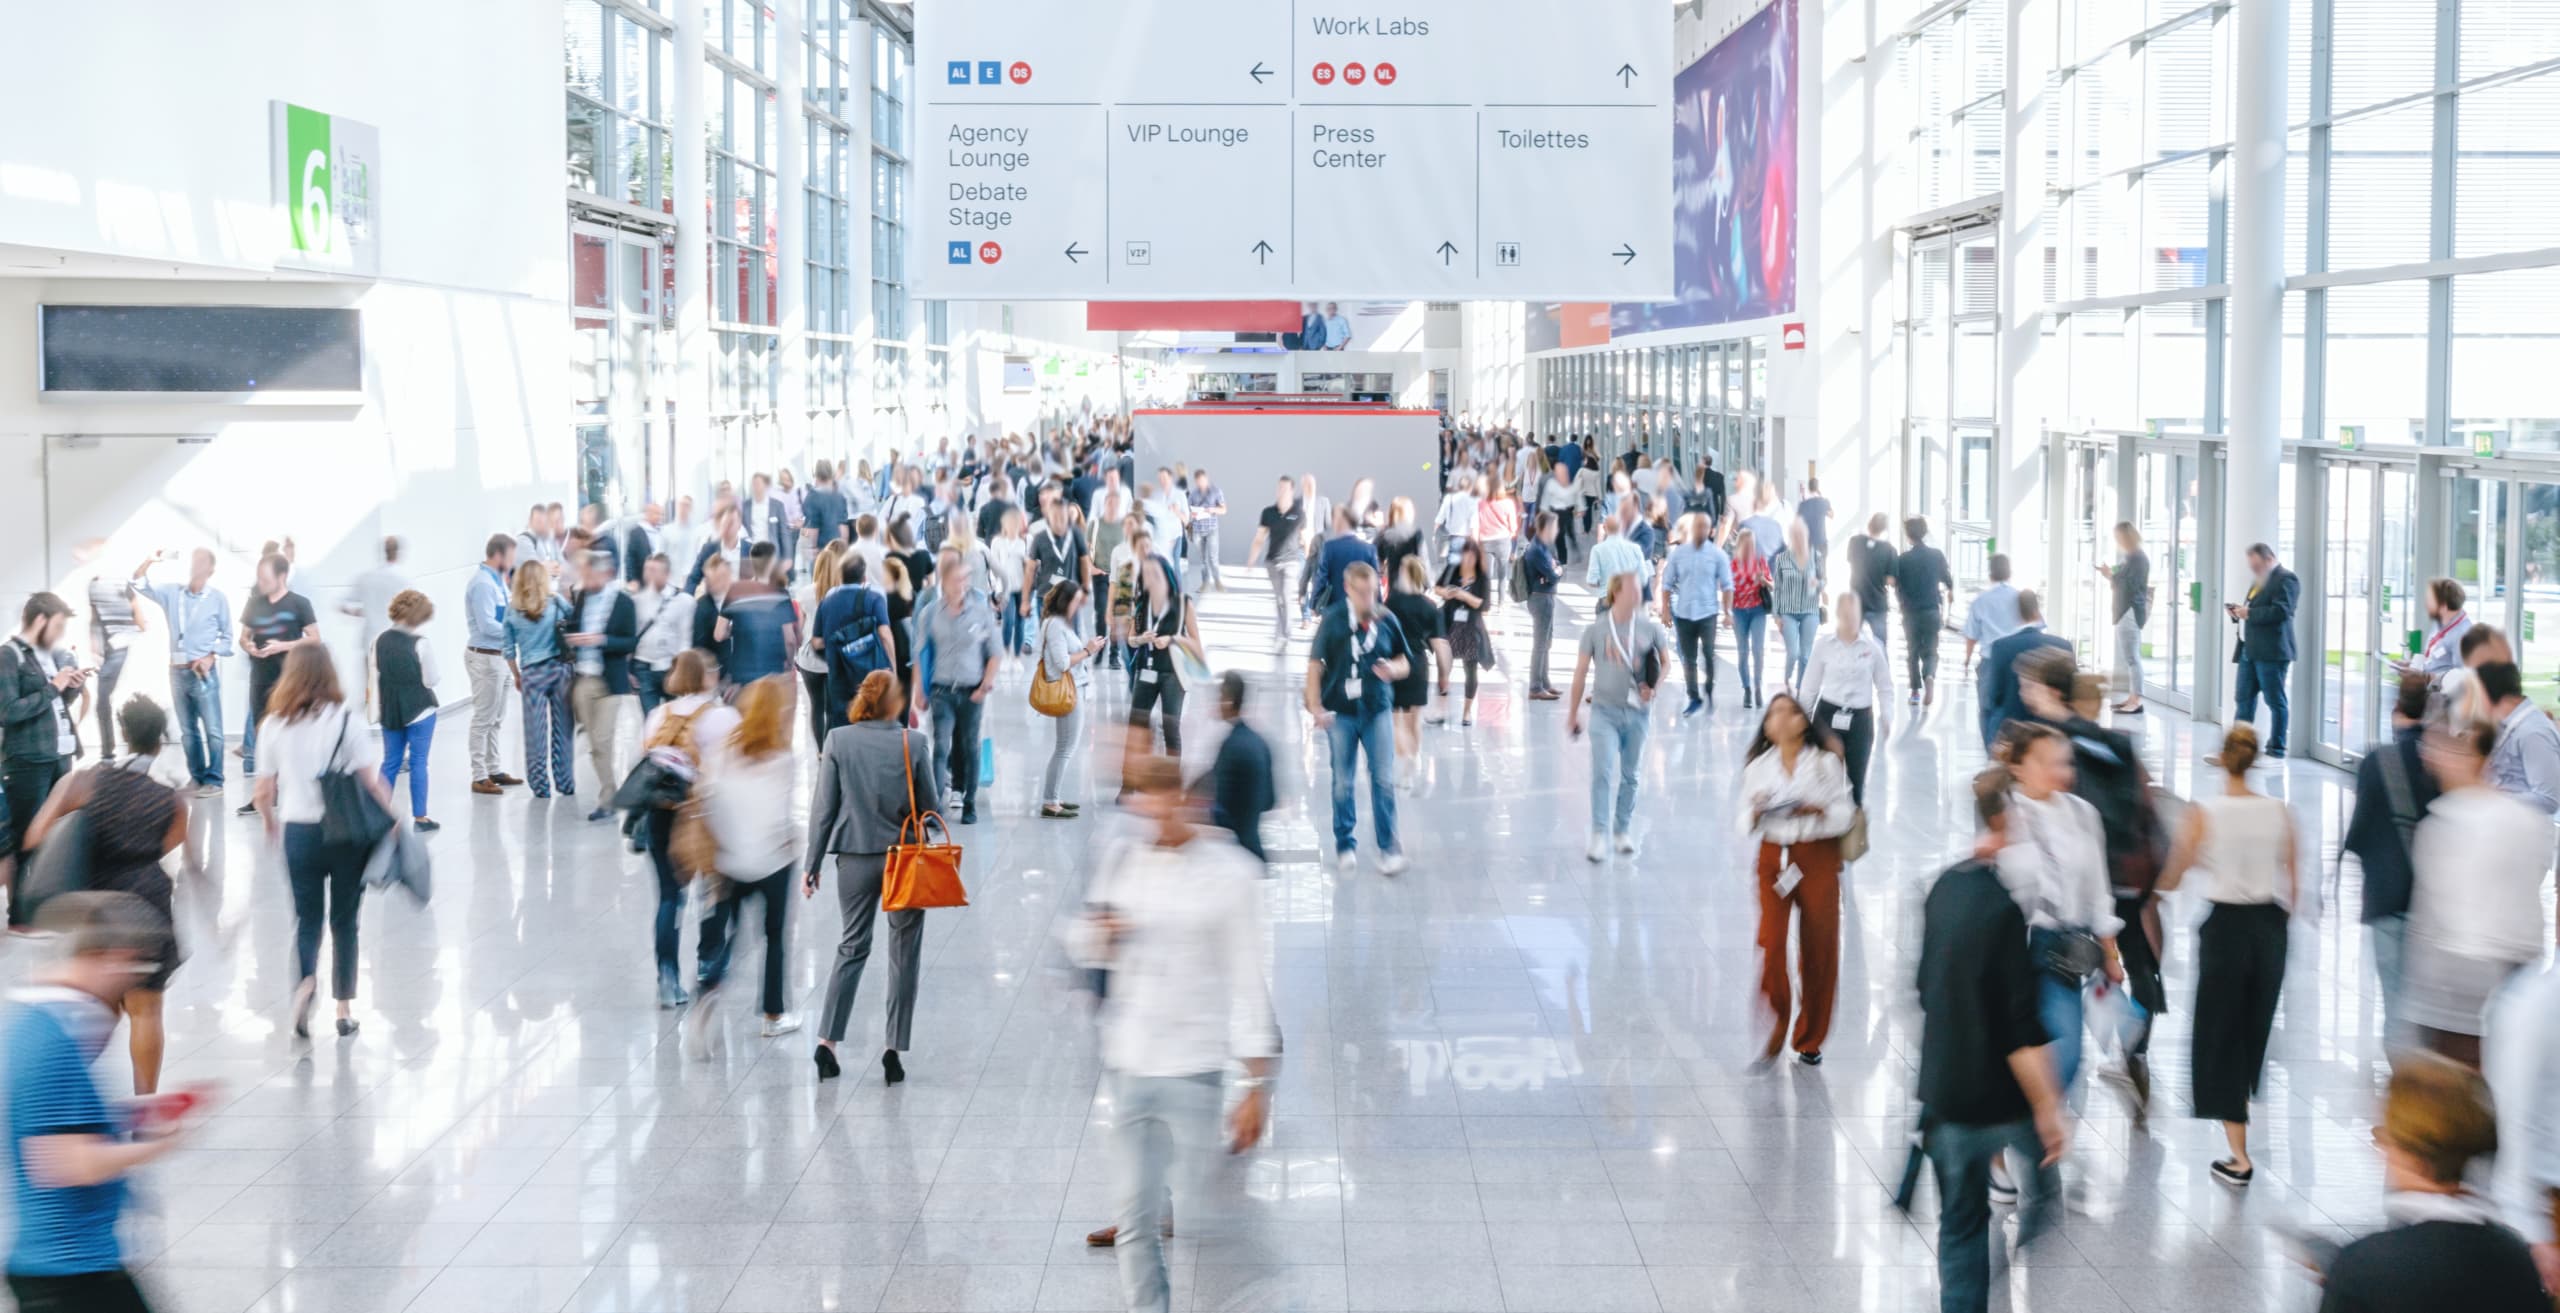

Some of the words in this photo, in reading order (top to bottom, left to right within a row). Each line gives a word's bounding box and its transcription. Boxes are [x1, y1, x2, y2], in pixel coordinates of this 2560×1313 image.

[1312, 16, 1370, 36] Work
[1376, 16, 1430, 36] Labs
[951, 67, 967, 79] AL
[986, 67, 994, 79] E
[1012, 67, 1029, 79] DS
[1316, 68, 1332, 80] ES
[1346, 68, 1362, 80] MS
[1377, 68, 1393, 80] WL
[948, 123, 1029, 146] Agency
[1127, 124, 1162, 143] VIP
[1167, 124, 1249, 147] Lounge
[1313, 124, 1375, 143] Press
[1497, 129, 1589, 149] Toilettes
[949, 149, 1030, 172] Lounge
[1312, 149, 1387, 168] Center
[949, 182, 1028, 201] Debate
[302, 149, 330, 254] 6
[949, 207, 1012, 231] Stage
[952, 247, 968, 259] AL
[982, 247, 999, 259] DS
[1130, 248, 1147, 258] VIP
